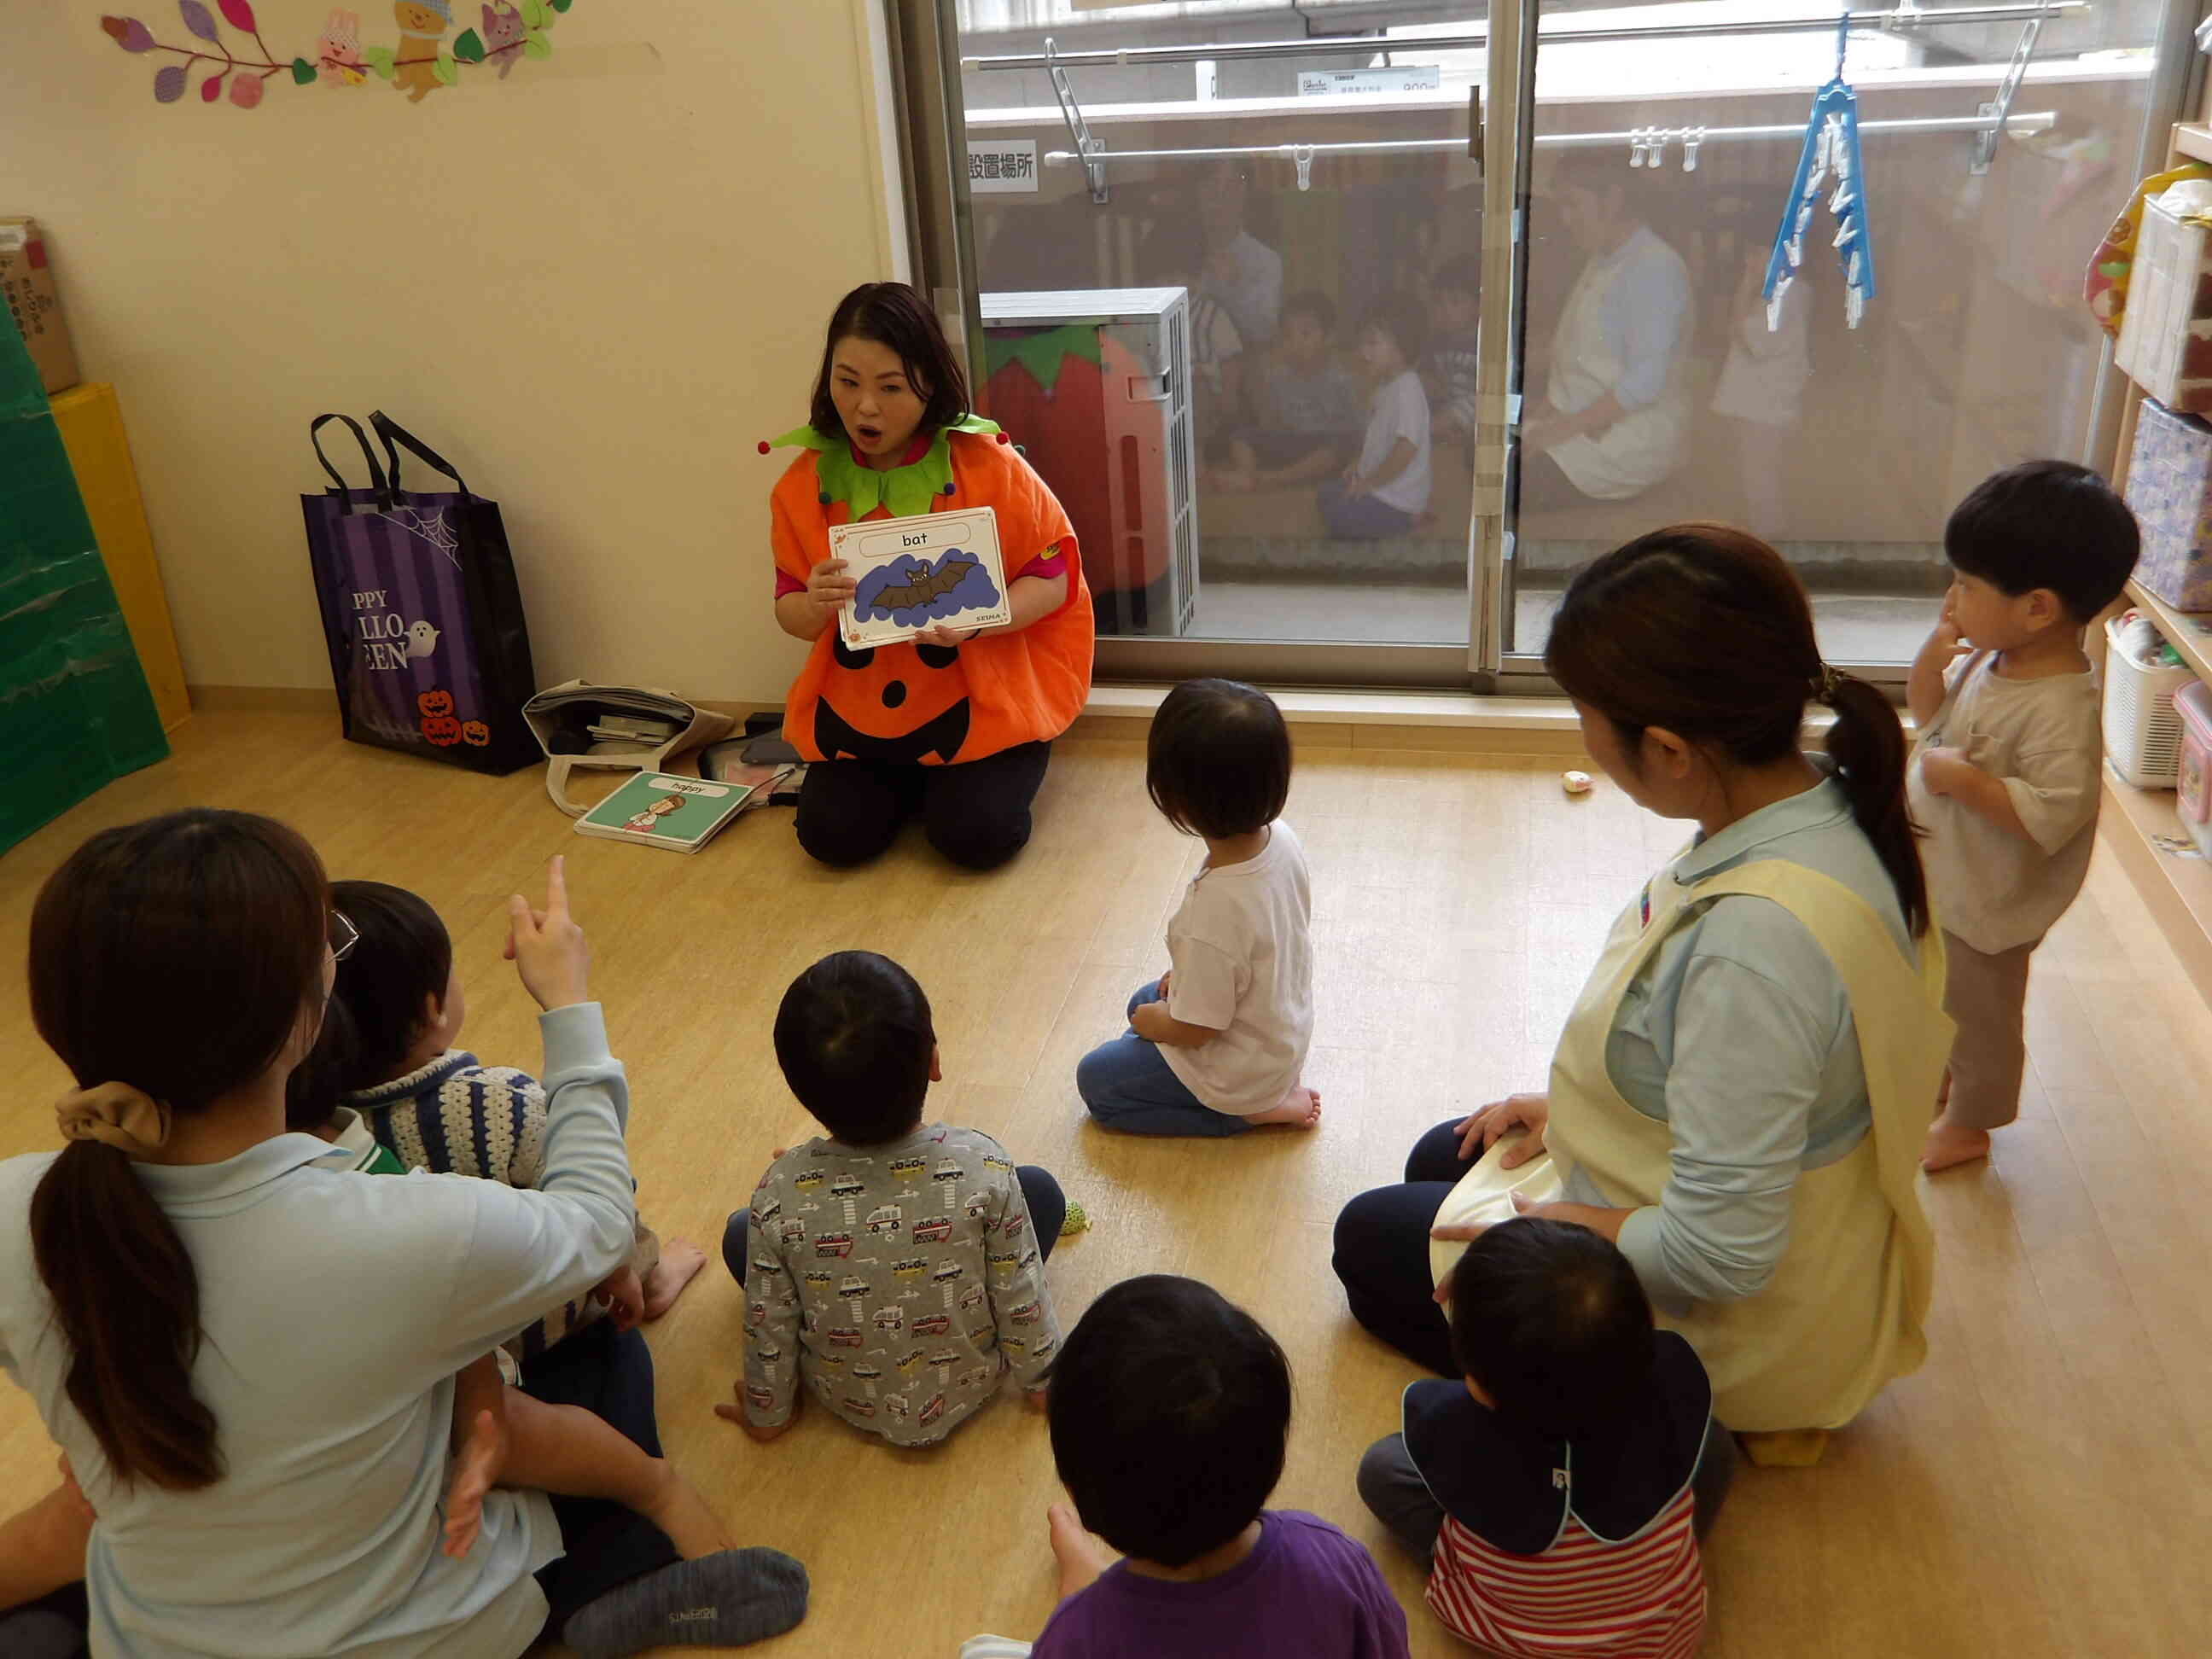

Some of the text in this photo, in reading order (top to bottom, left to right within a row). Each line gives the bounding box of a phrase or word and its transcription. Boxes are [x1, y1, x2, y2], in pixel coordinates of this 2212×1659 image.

[969, 153, 1033, 179] 設置場所
[902, 533, 928, 547] bat
[352, 590, 387, 609] PPY
[358, 613, 405, 640] LLO
[671, 782, 706, 794] happy
